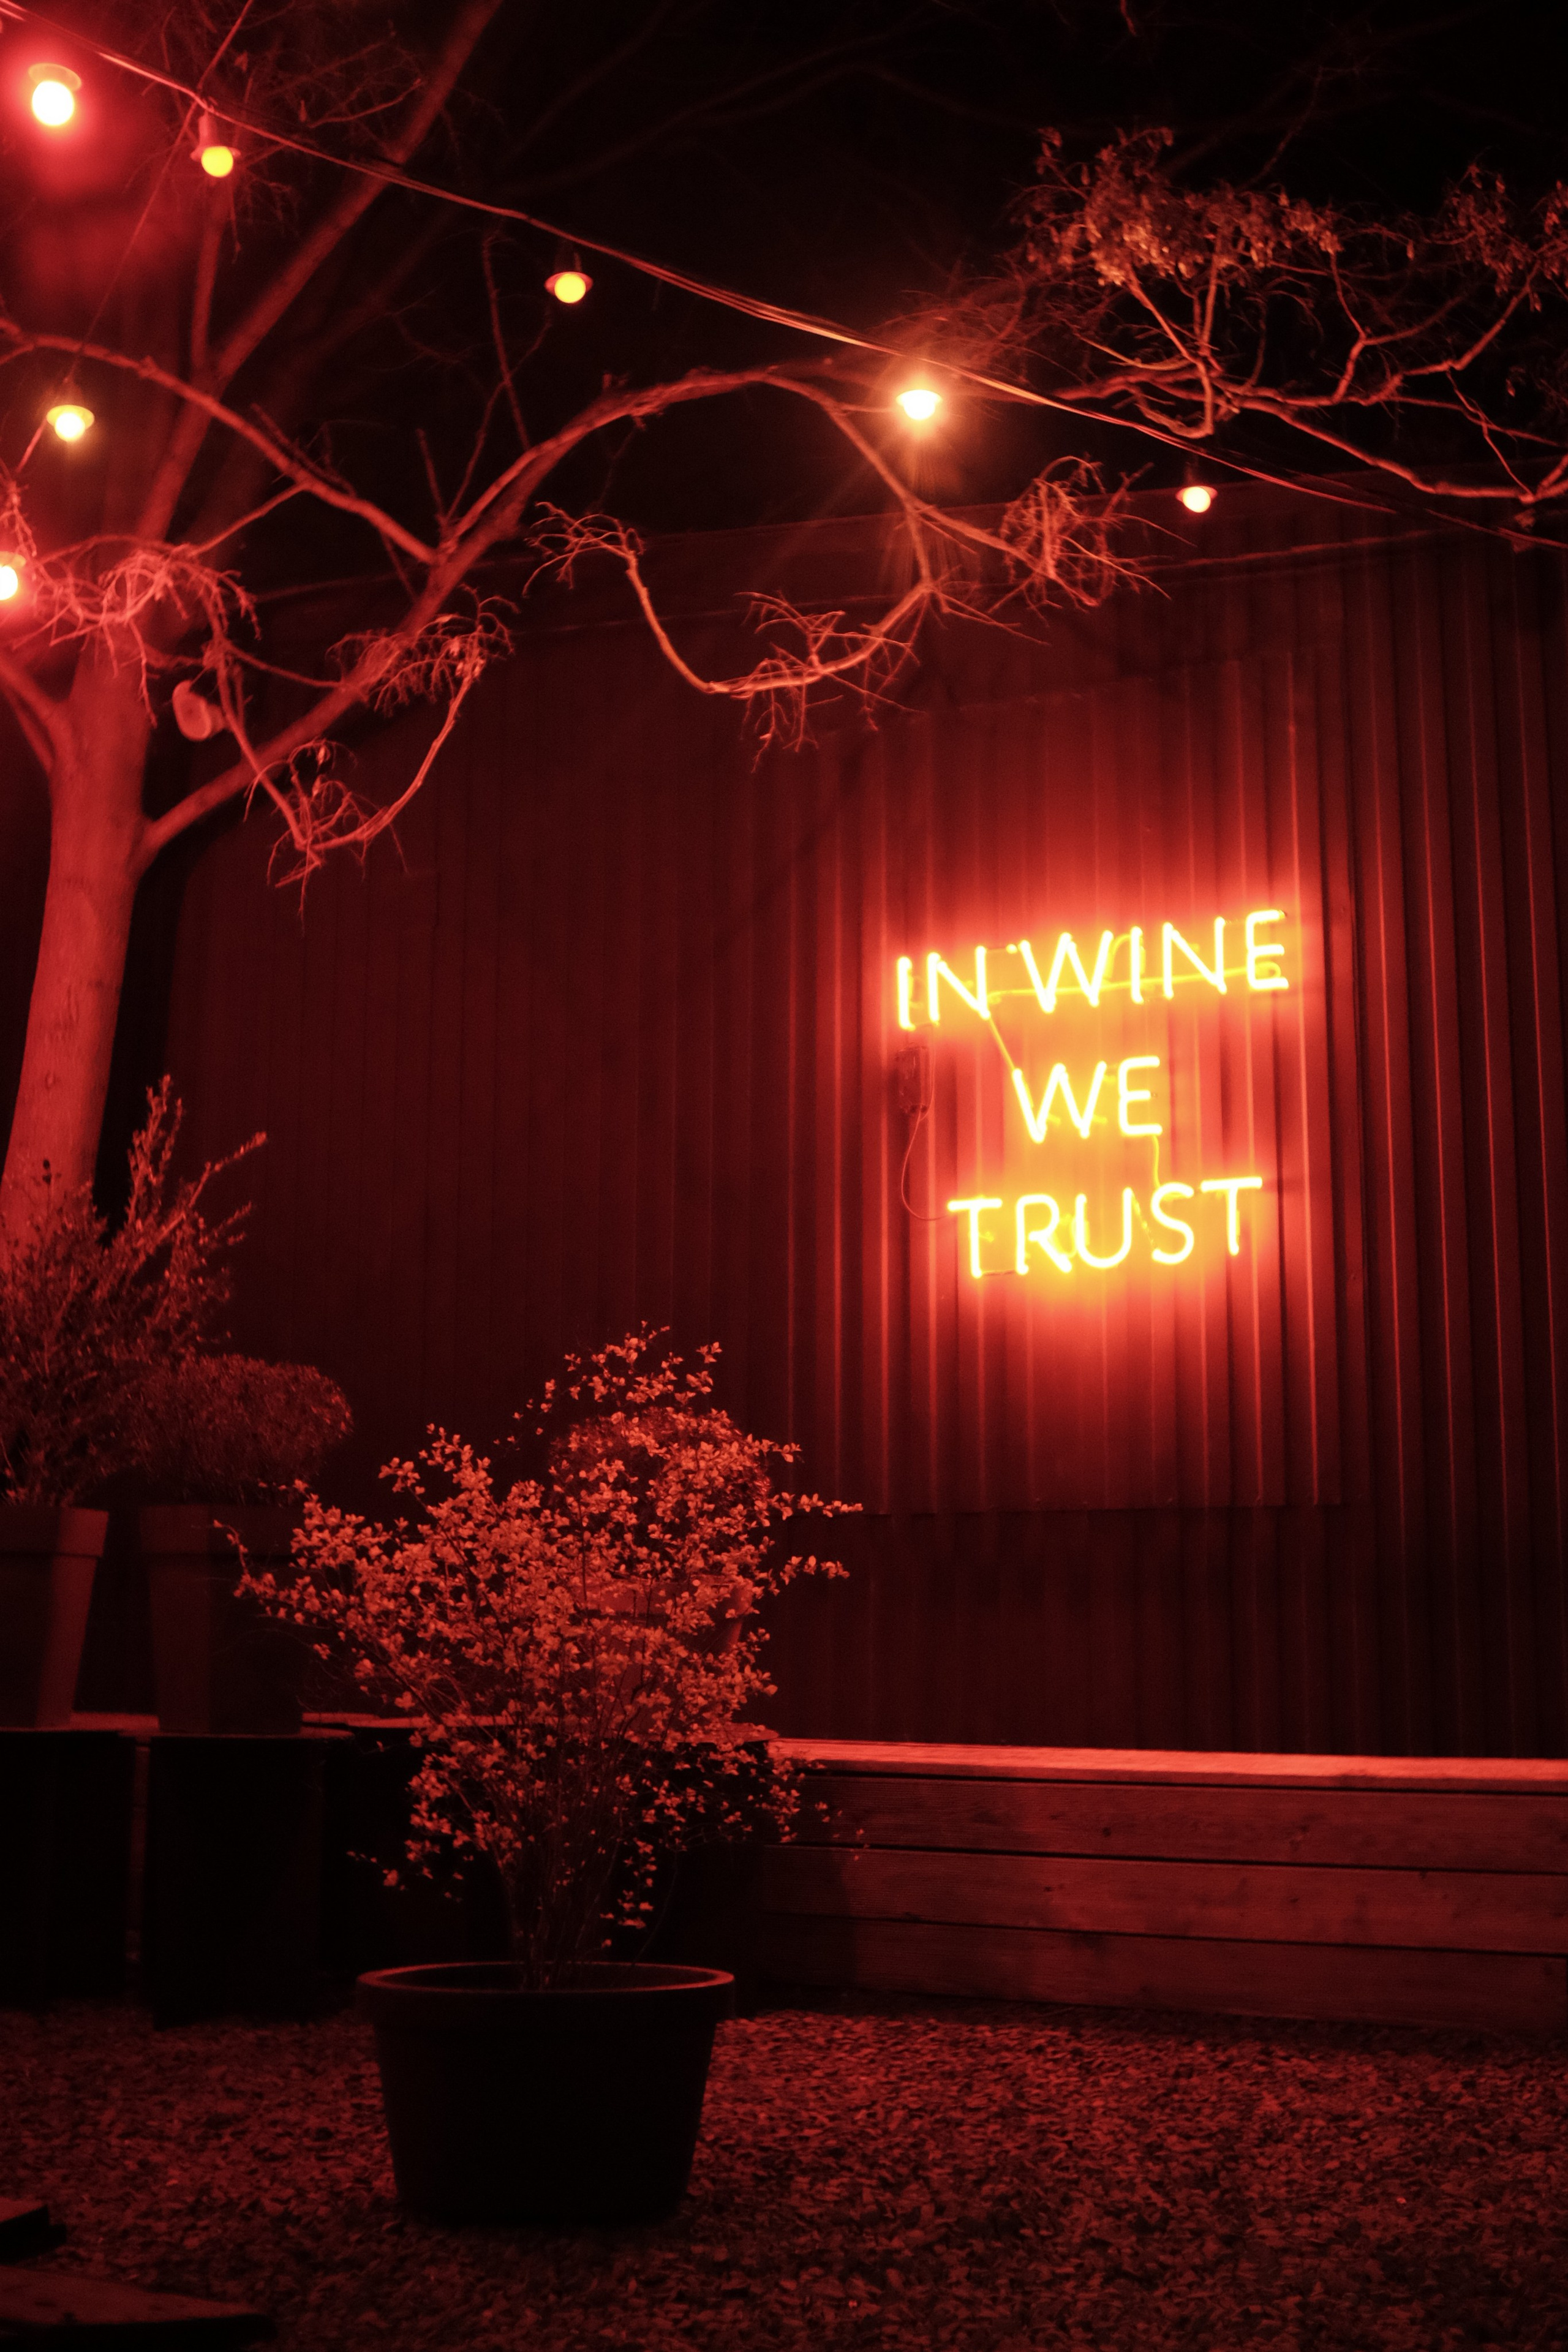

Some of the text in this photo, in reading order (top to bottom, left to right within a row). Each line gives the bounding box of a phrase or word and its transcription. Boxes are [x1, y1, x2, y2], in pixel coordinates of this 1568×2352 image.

[897, 909, 1289, 1031] IN WINE
[1012, 1055, 1163, 1143] WE
[947, 1177, 1263, 1278] TRUST
